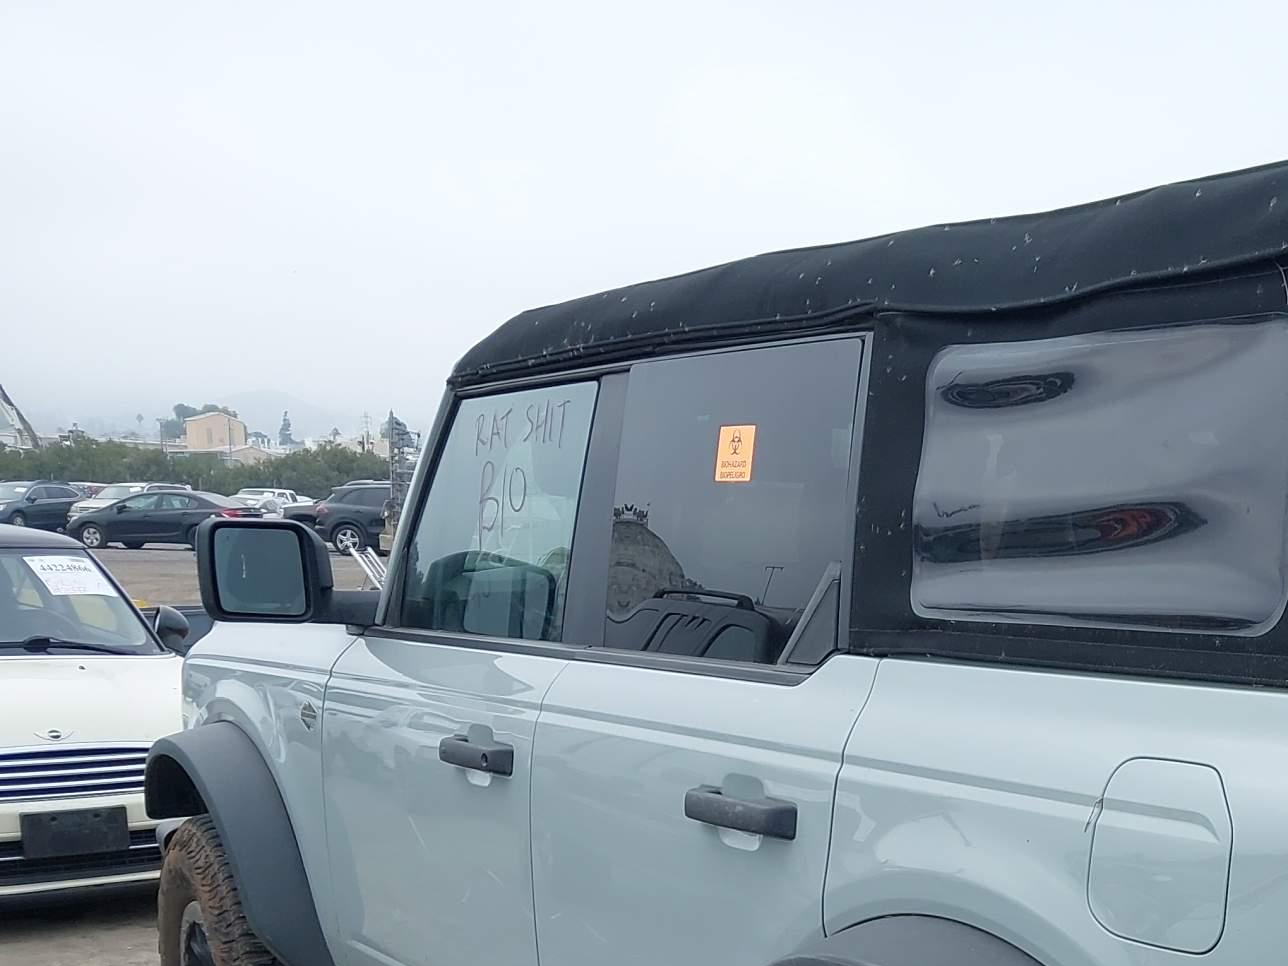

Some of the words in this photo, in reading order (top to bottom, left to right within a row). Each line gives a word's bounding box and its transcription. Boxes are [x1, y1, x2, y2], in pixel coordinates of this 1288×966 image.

[475, 407, 513, 457] RAT
[522, 398, 572, 449] SHIT
[478, 460, 527, 551] BIO
